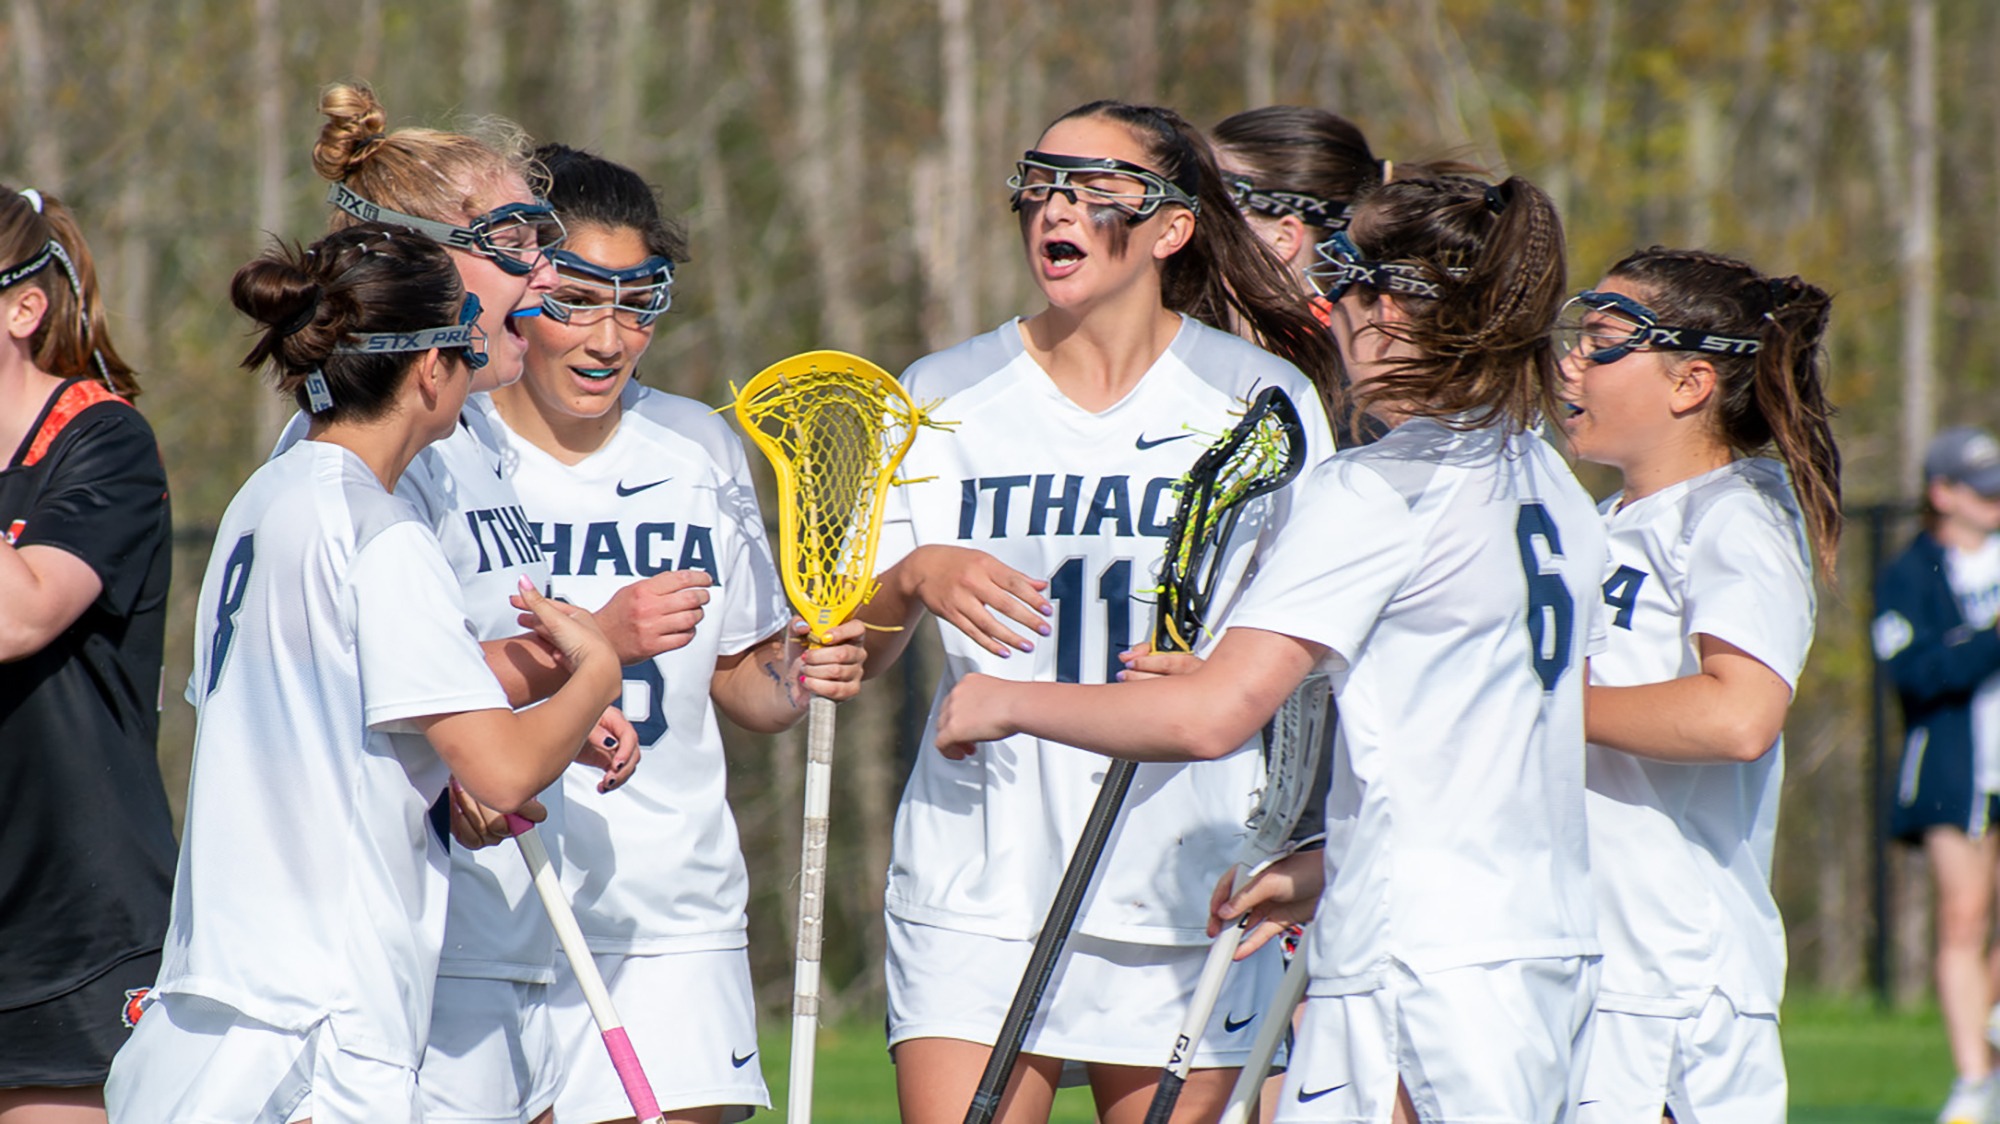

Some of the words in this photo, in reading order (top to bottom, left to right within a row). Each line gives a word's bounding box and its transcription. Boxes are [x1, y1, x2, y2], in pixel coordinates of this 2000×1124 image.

[336, 186, 365, 215] STX
[1249, 193, 1306, 221] STX
[1342, 264, 1377, 284] TX
[1389, 275, 1439, 298] STX
[368, 333, 420, 350] STX
[1649, 329, 1682, 345] TX
[1515, 499, 1575, 694] 6
[206, 535, 255, 698] 8
[1048, 553, 1135, 684] 11
